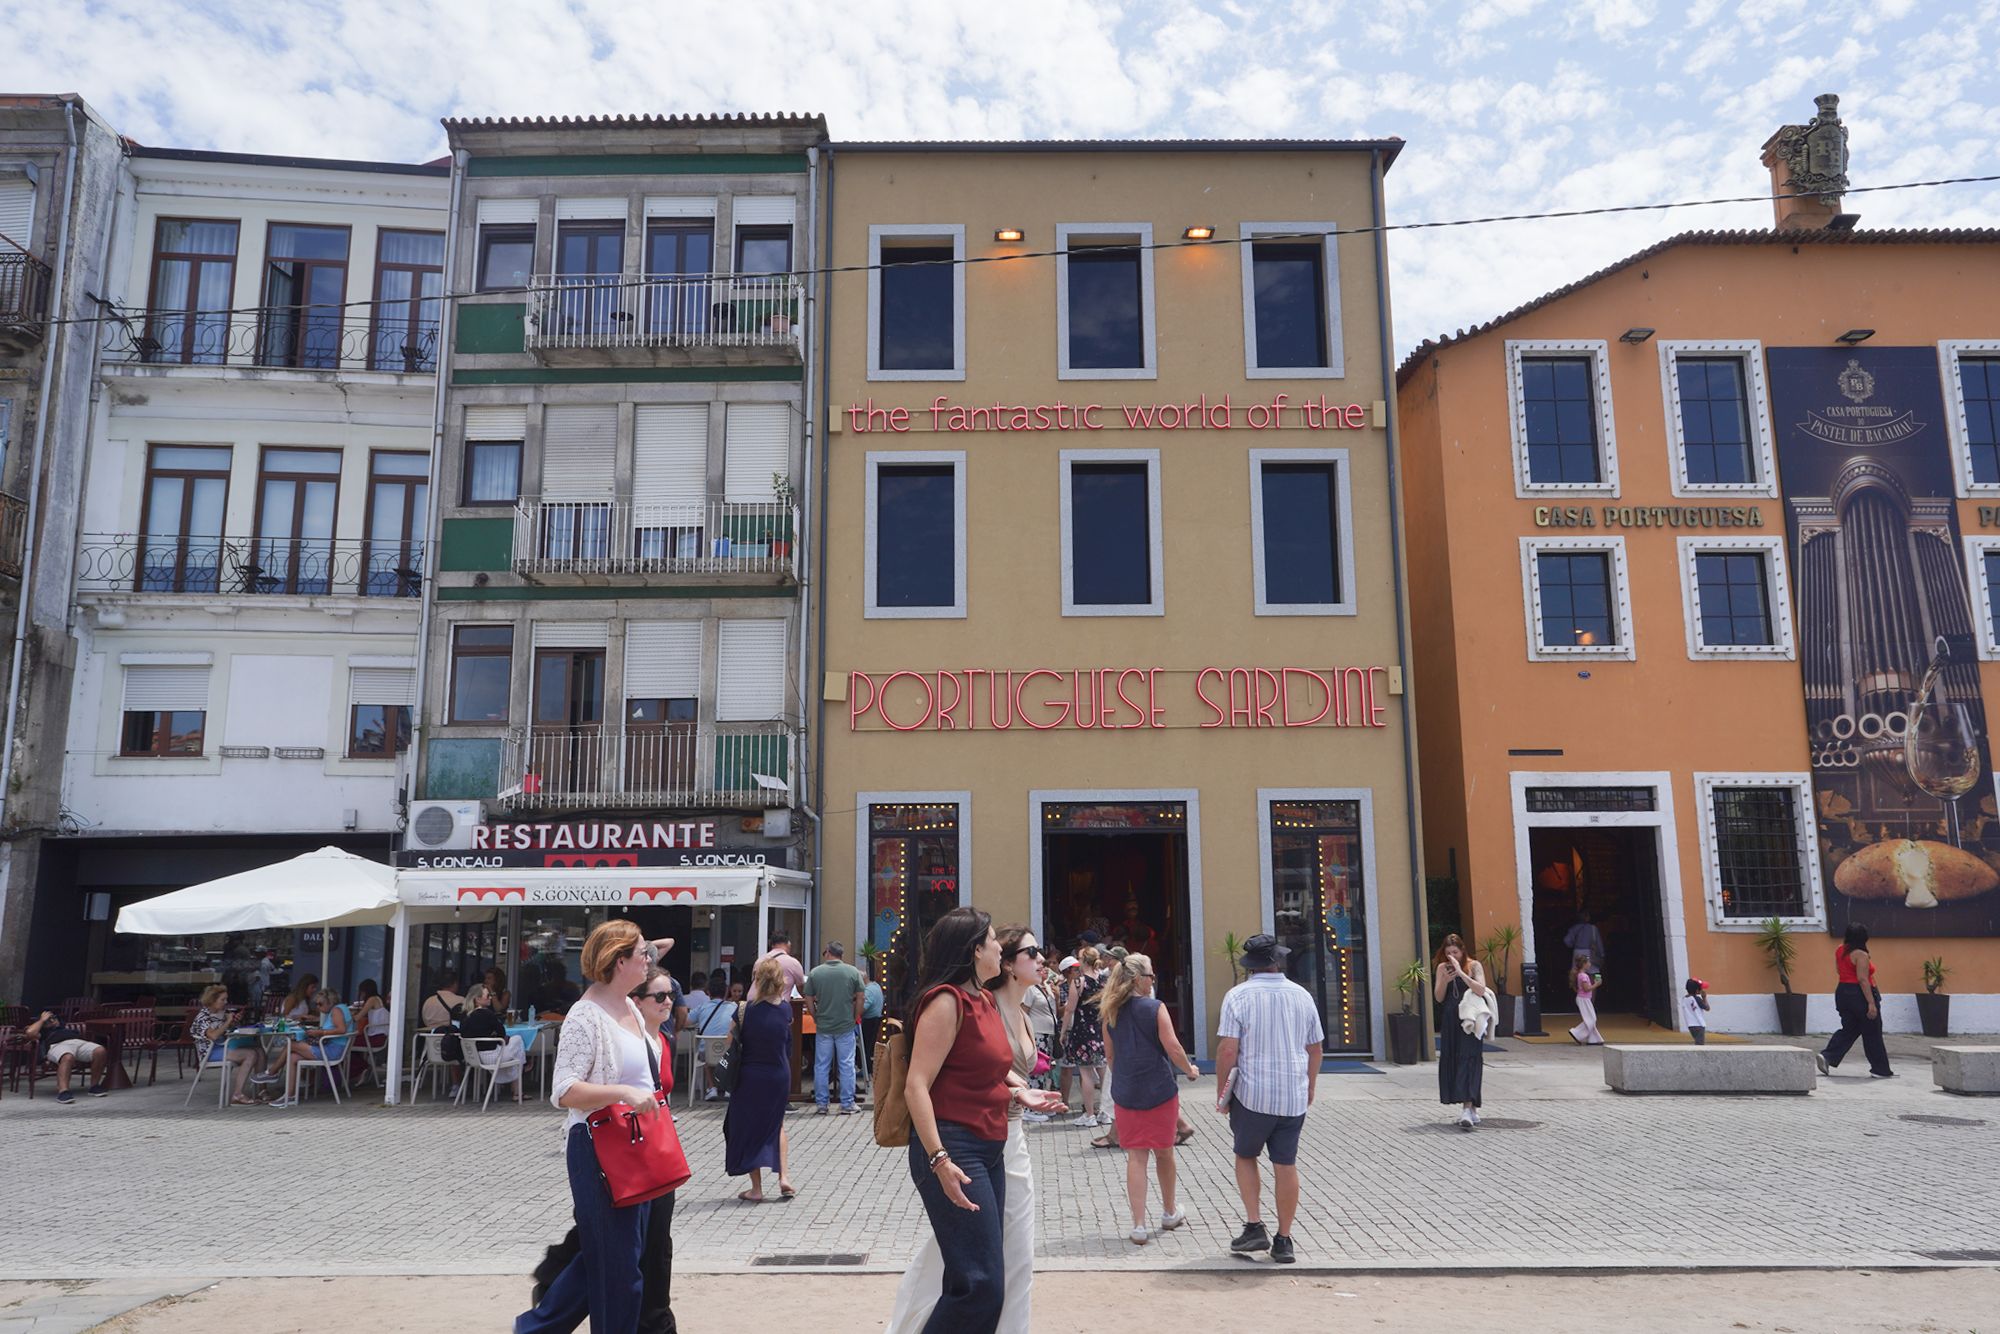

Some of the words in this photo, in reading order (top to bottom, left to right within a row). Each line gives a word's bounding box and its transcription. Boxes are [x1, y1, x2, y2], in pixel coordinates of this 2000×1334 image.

[848, 397, 911, 432] the
[929, 396, 1104, 432] fantastic
[1121, 393, 1232, 429] world
[1247, 394, 1289, 429] of
[1303, 394, 1366, 429] the
[1826, 406, 1845, 417] CASA
[1845, 406, 1893, 417] PORTUGUESA
[1810, 419, 1848, 441] PASTEL
[1850, 429, 1864, 443] DE
[1534, 506, 1596, 527] CASA
[1603, 506, 1764, 528] PORTUGUESA
[851, 668, 1167, 731] PORTUGUESE
[1197, 667, 1387, 728] SARDINE
[471, 822, 715, 850] RESTAURANTE
[417, 856, 430, 869] S.
[680, 854, 693, 866] S.
[532, 889, 622, 904] S.GONÇALO
[303, 933, 333, 941] DALA
